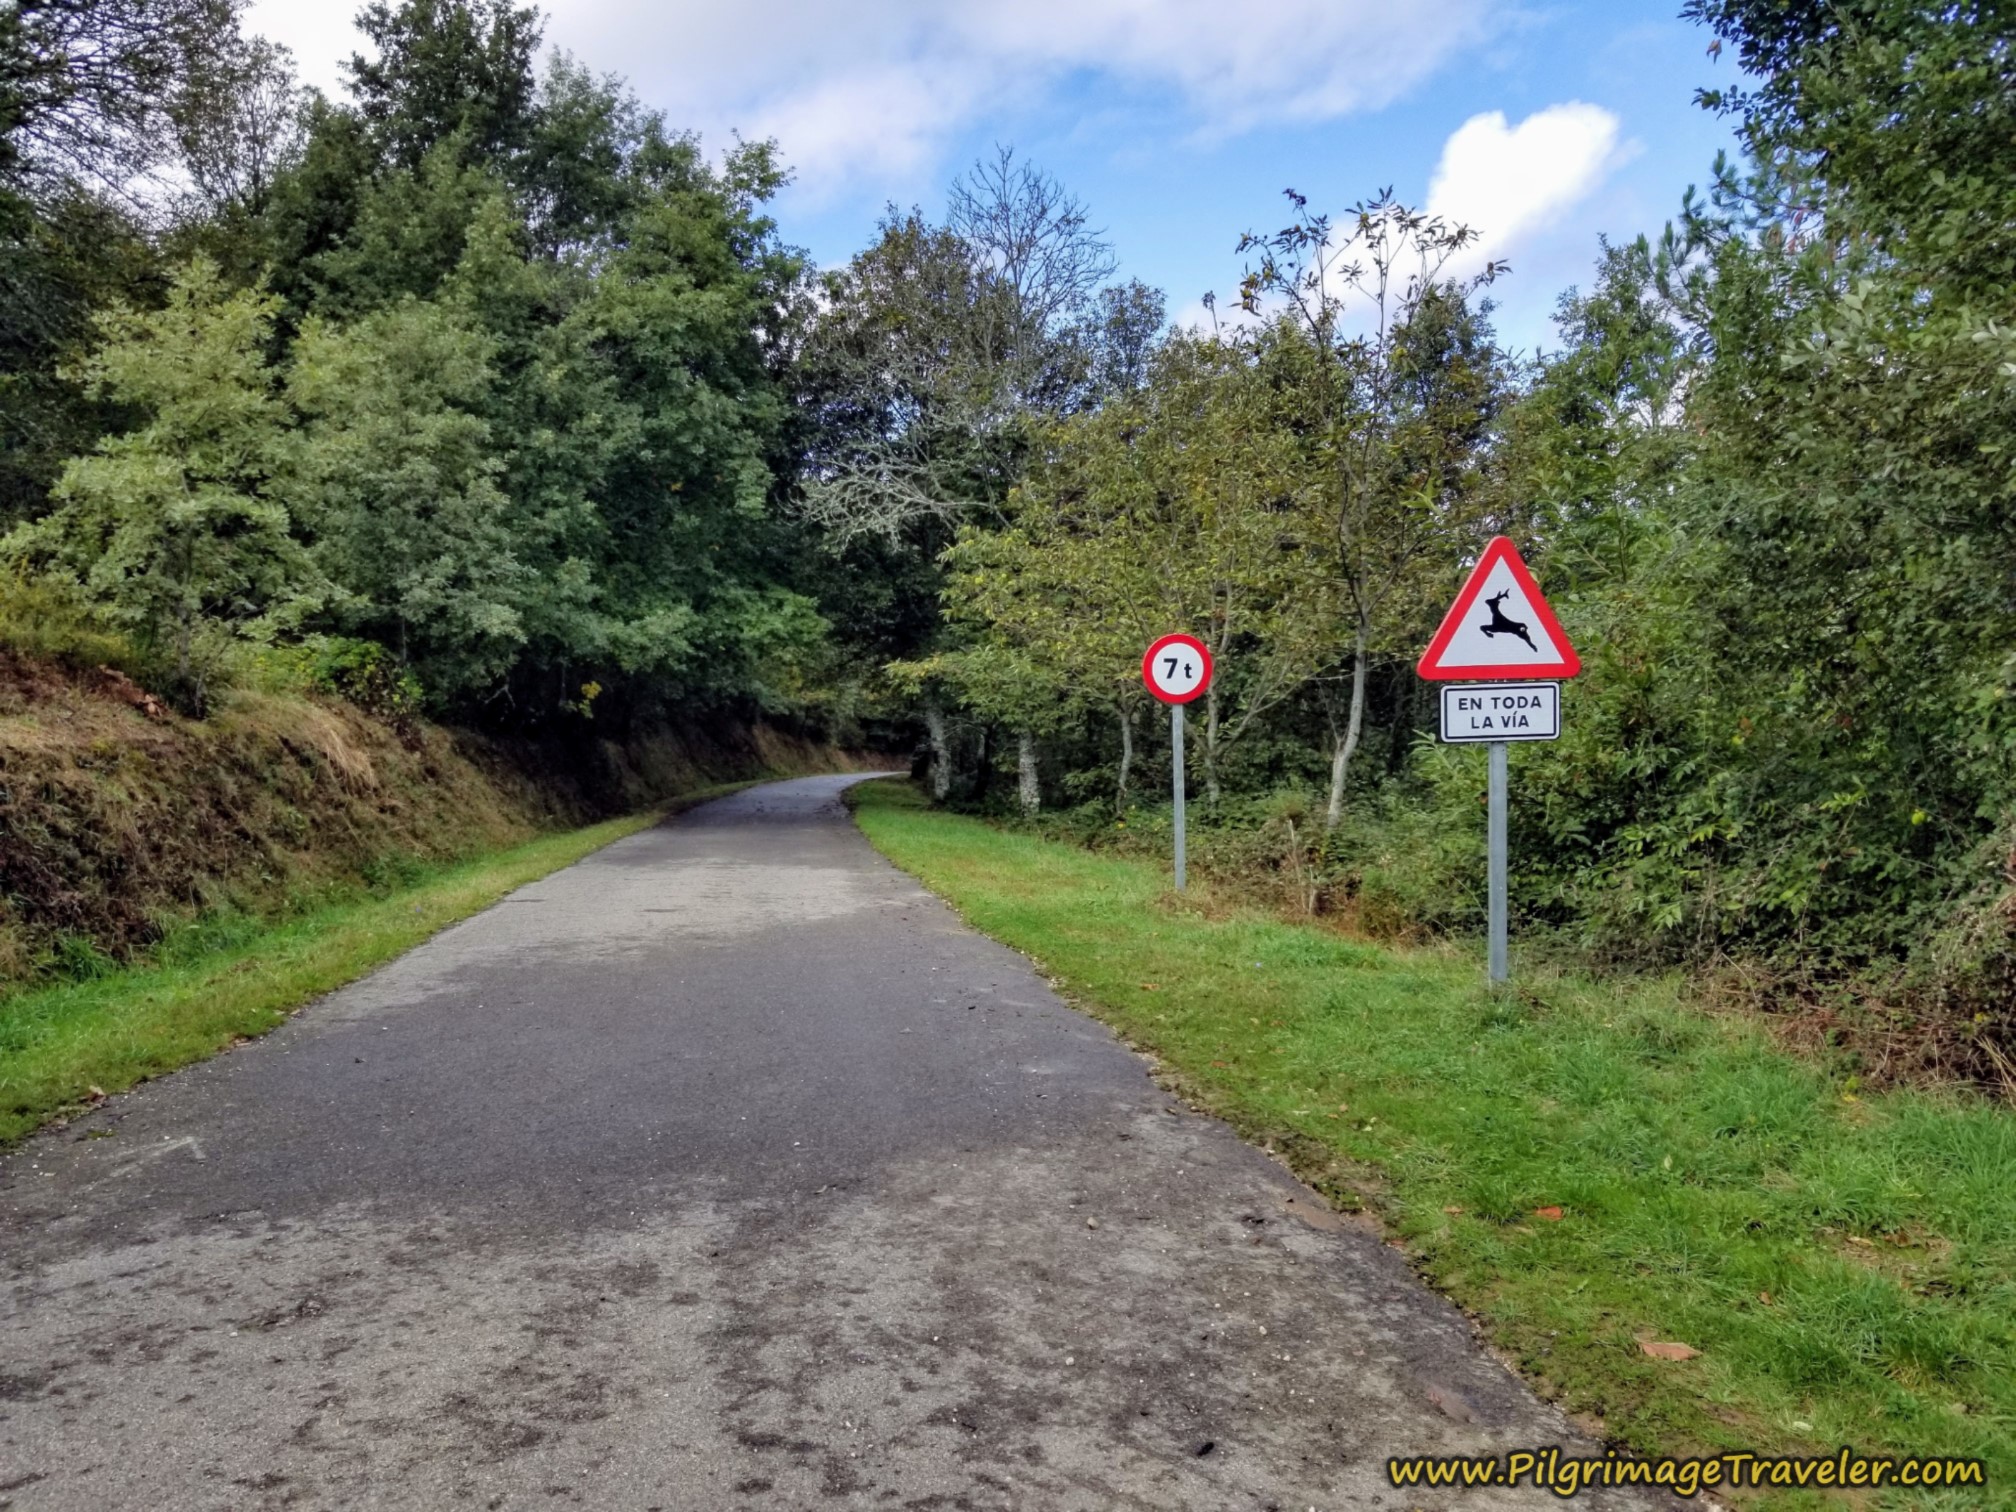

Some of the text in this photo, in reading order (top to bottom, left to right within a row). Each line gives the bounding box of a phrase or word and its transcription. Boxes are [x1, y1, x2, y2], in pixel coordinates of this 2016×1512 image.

[1163, 658, 1193, 679] 7 t
[1458, 696, 1542, 710] EN TODA
[1470, 710, 1529, 729] LA VÍA
